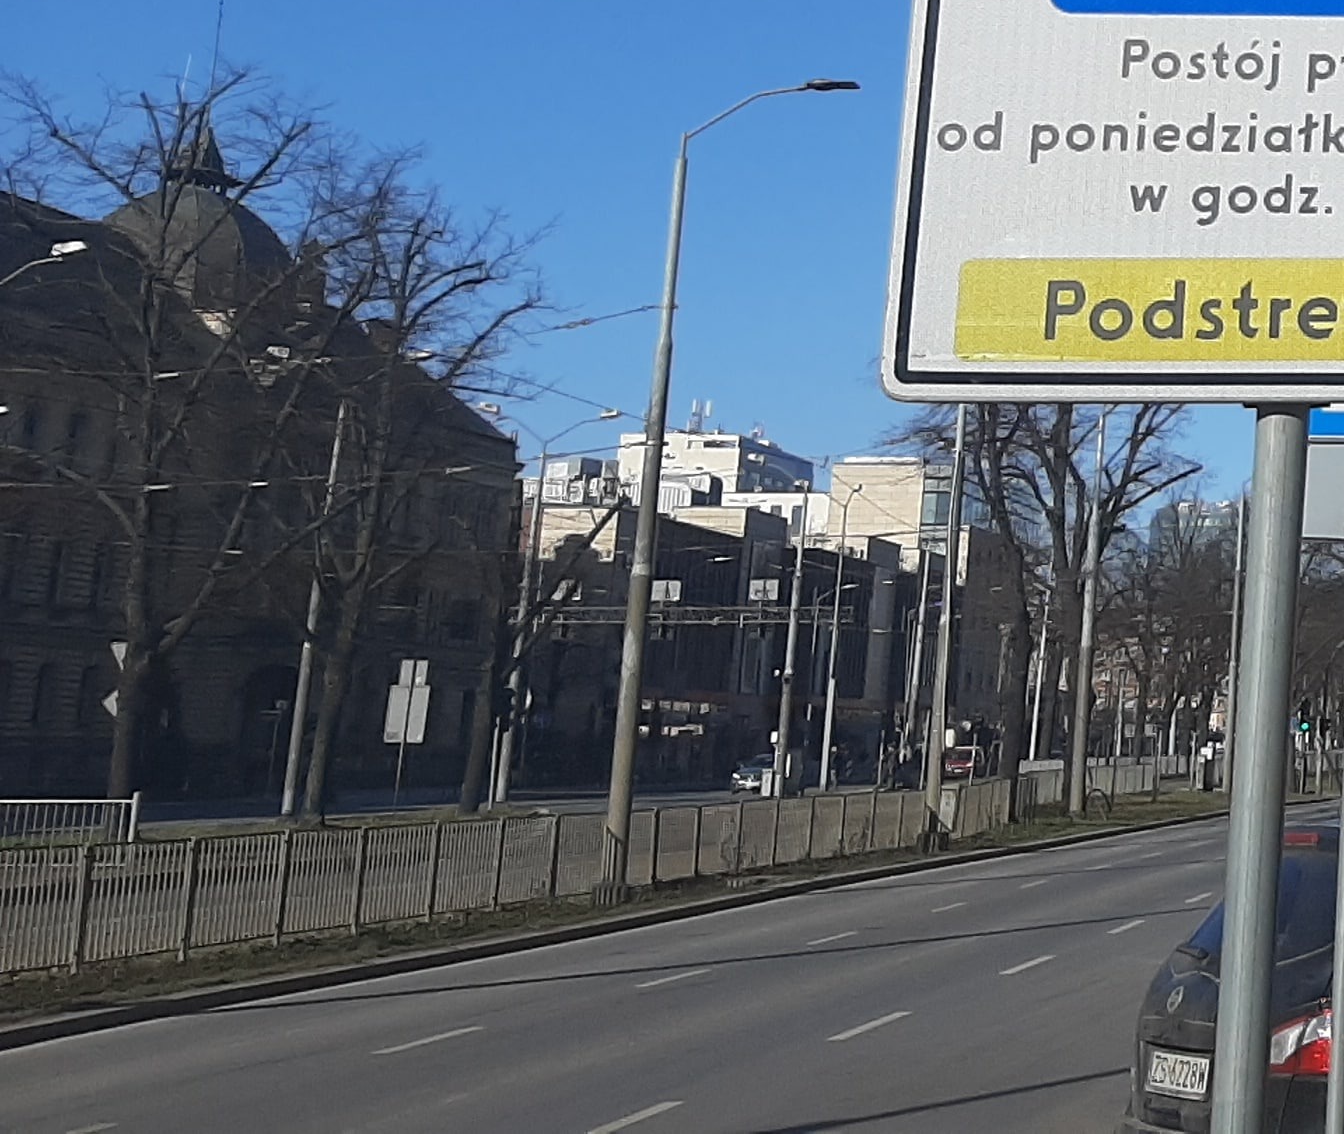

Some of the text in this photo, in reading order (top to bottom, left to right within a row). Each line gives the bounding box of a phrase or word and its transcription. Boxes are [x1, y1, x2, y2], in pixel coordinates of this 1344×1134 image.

[1121, 39, 1281, 91] Postój
[937, 111, 1003, 152] od
[1130, 184, 1168, 213] w
[1192, 174, 1333, 226] godz.
